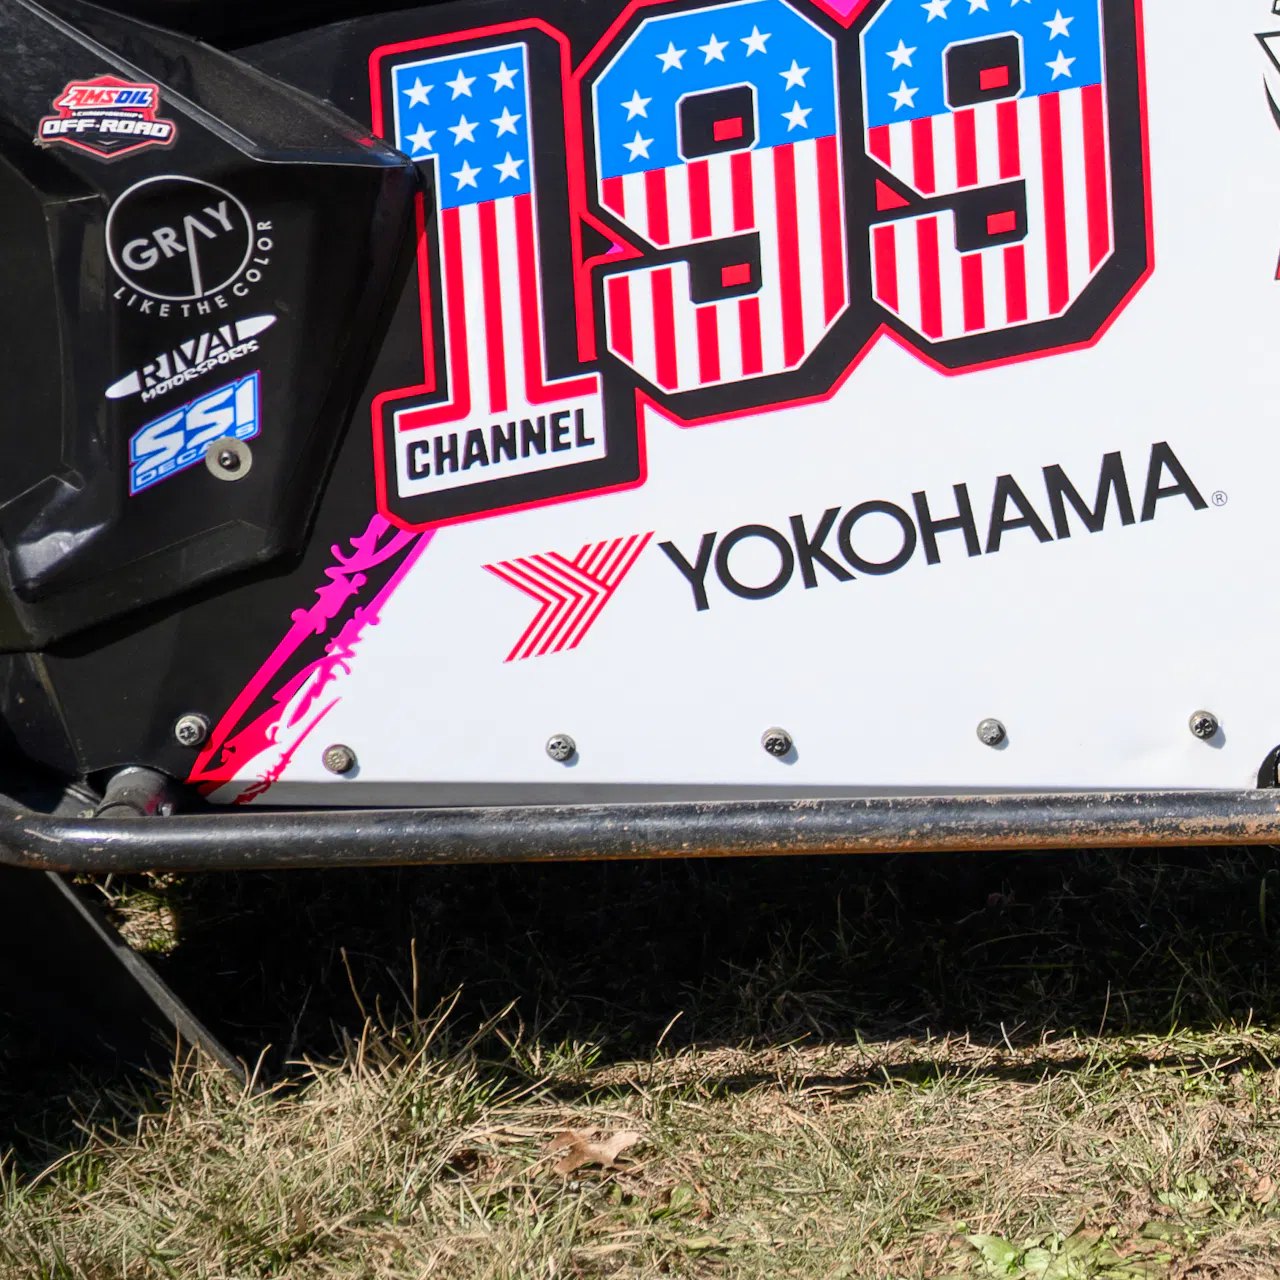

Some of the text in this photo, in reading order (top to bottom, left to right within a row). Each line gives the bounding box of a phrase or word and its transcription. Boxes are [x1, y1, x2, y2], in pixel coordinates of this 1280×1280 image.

[42, 119, 172, 138] OFF-ROAD
[63, 87, 153, 107] AMSOIL
[113, 220, 273, 318] LIKE THE COLOR
[122, 200, 234, 296] GRAY
[140, 314, 277, 388] RIVAL
[141, 339, 259, 403] MOTORSPORTS
[134, 378, 256, 472] SSI
[405, 407, 596, 481] CHANNEL
[659, 440, 1209, 612] YOKOHAMA
